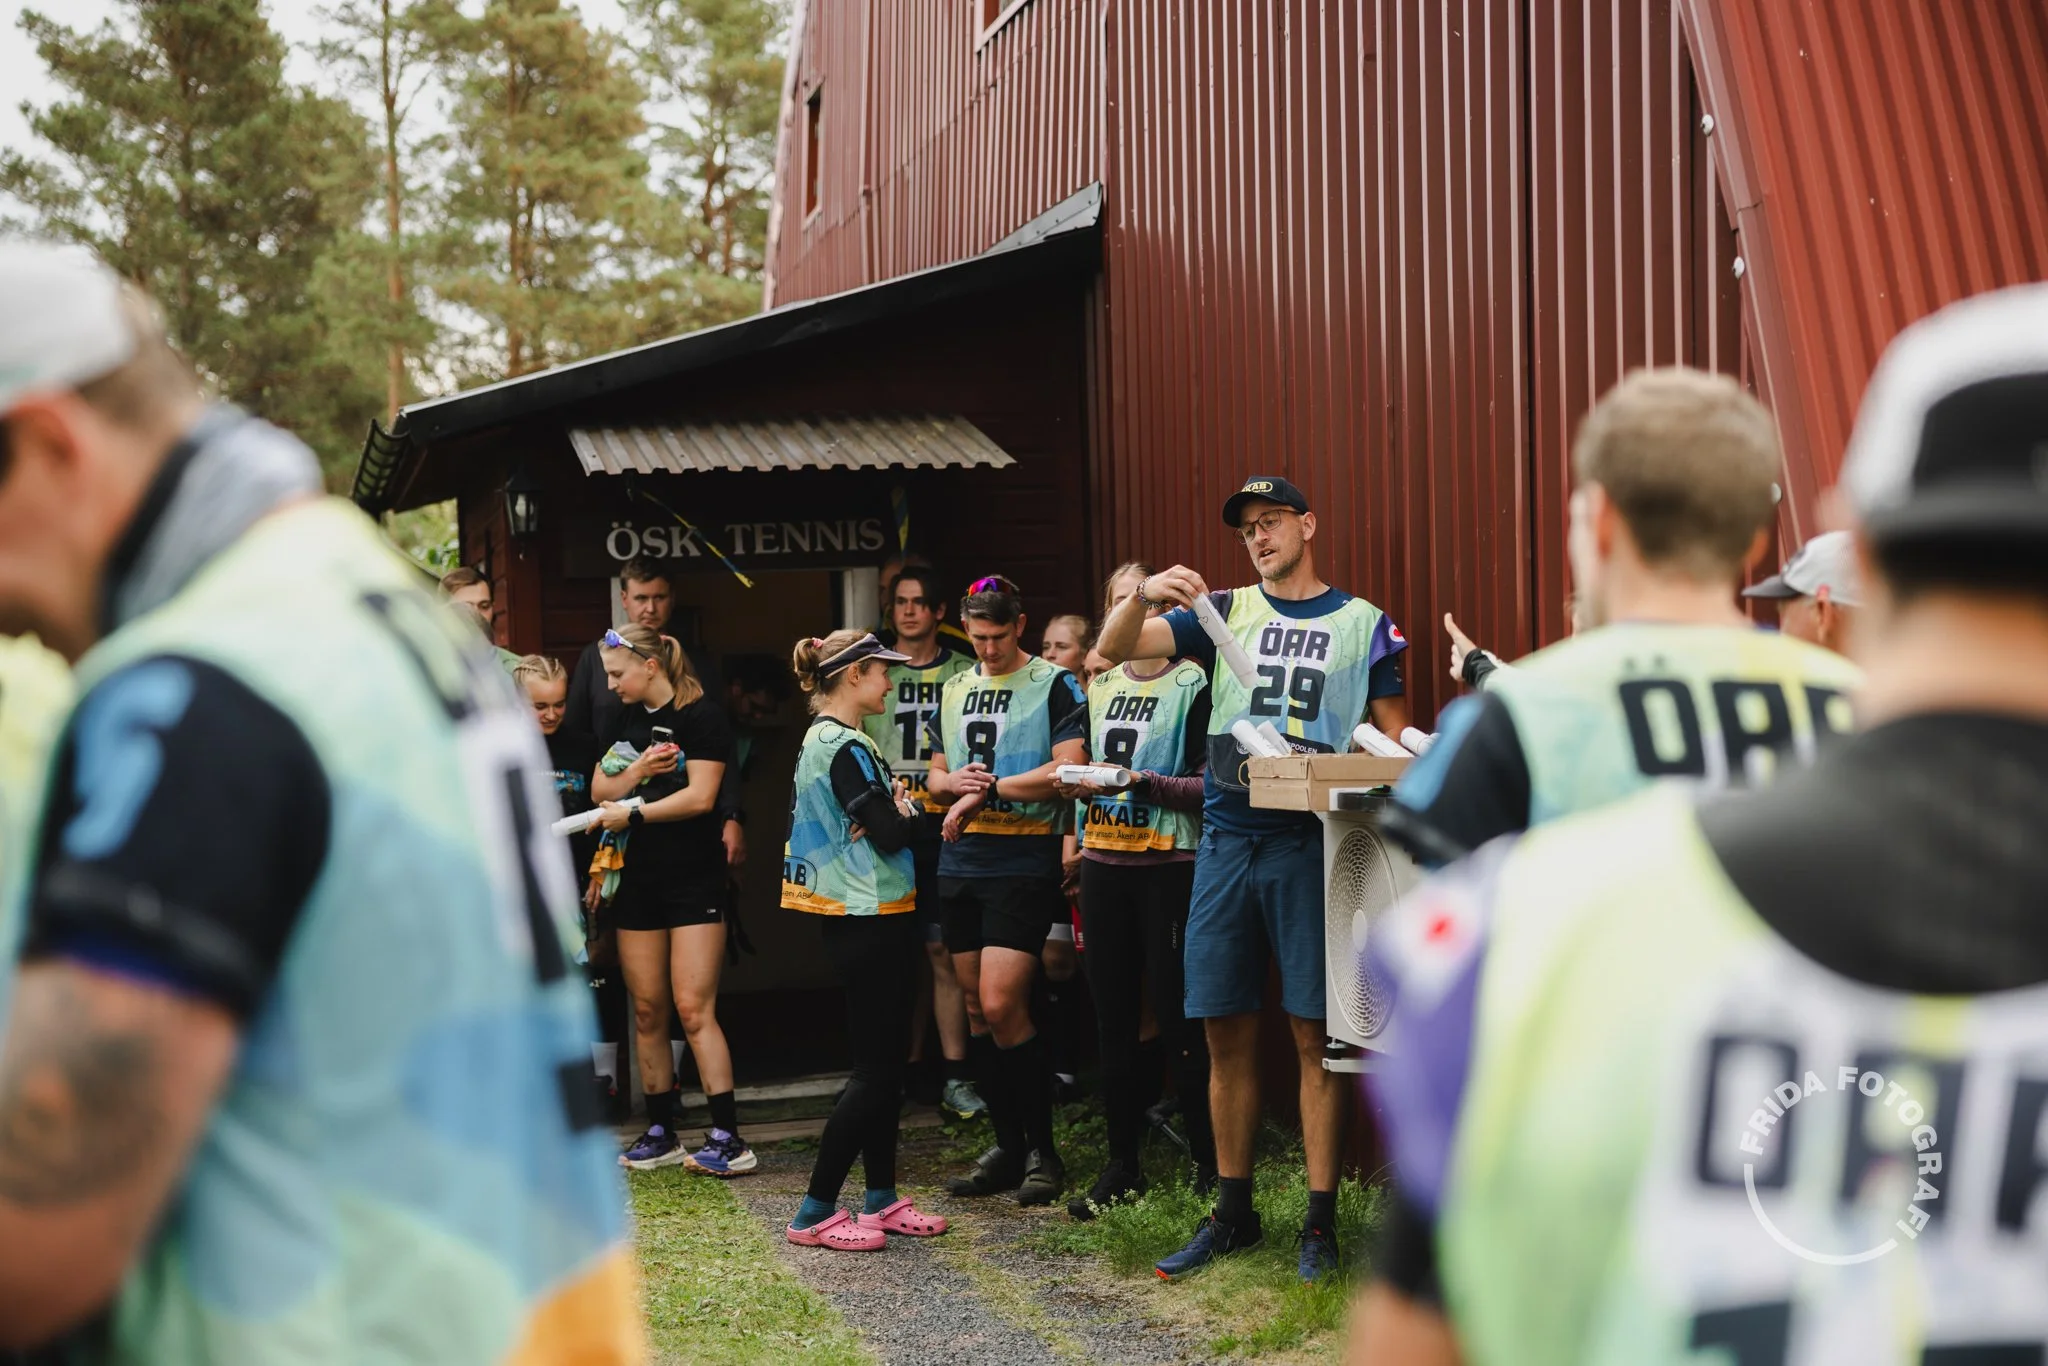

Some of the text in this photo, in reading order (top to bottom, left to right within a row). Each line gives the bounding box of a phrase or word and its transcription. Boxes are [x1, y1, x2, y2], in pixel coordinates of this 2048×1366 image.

[606, 518, 885, 561] ÖSK TENNIS
[1259, 622, 1331, 662] ÖAR
[962, 686, 1013, 716] ÖAR
[1105, 691, 1159, 722] ÖAR
[1250, 664, 1326, 722] 29
[966, 721, 997, 774] 8
[1104, 728, 1138, 771] 8
